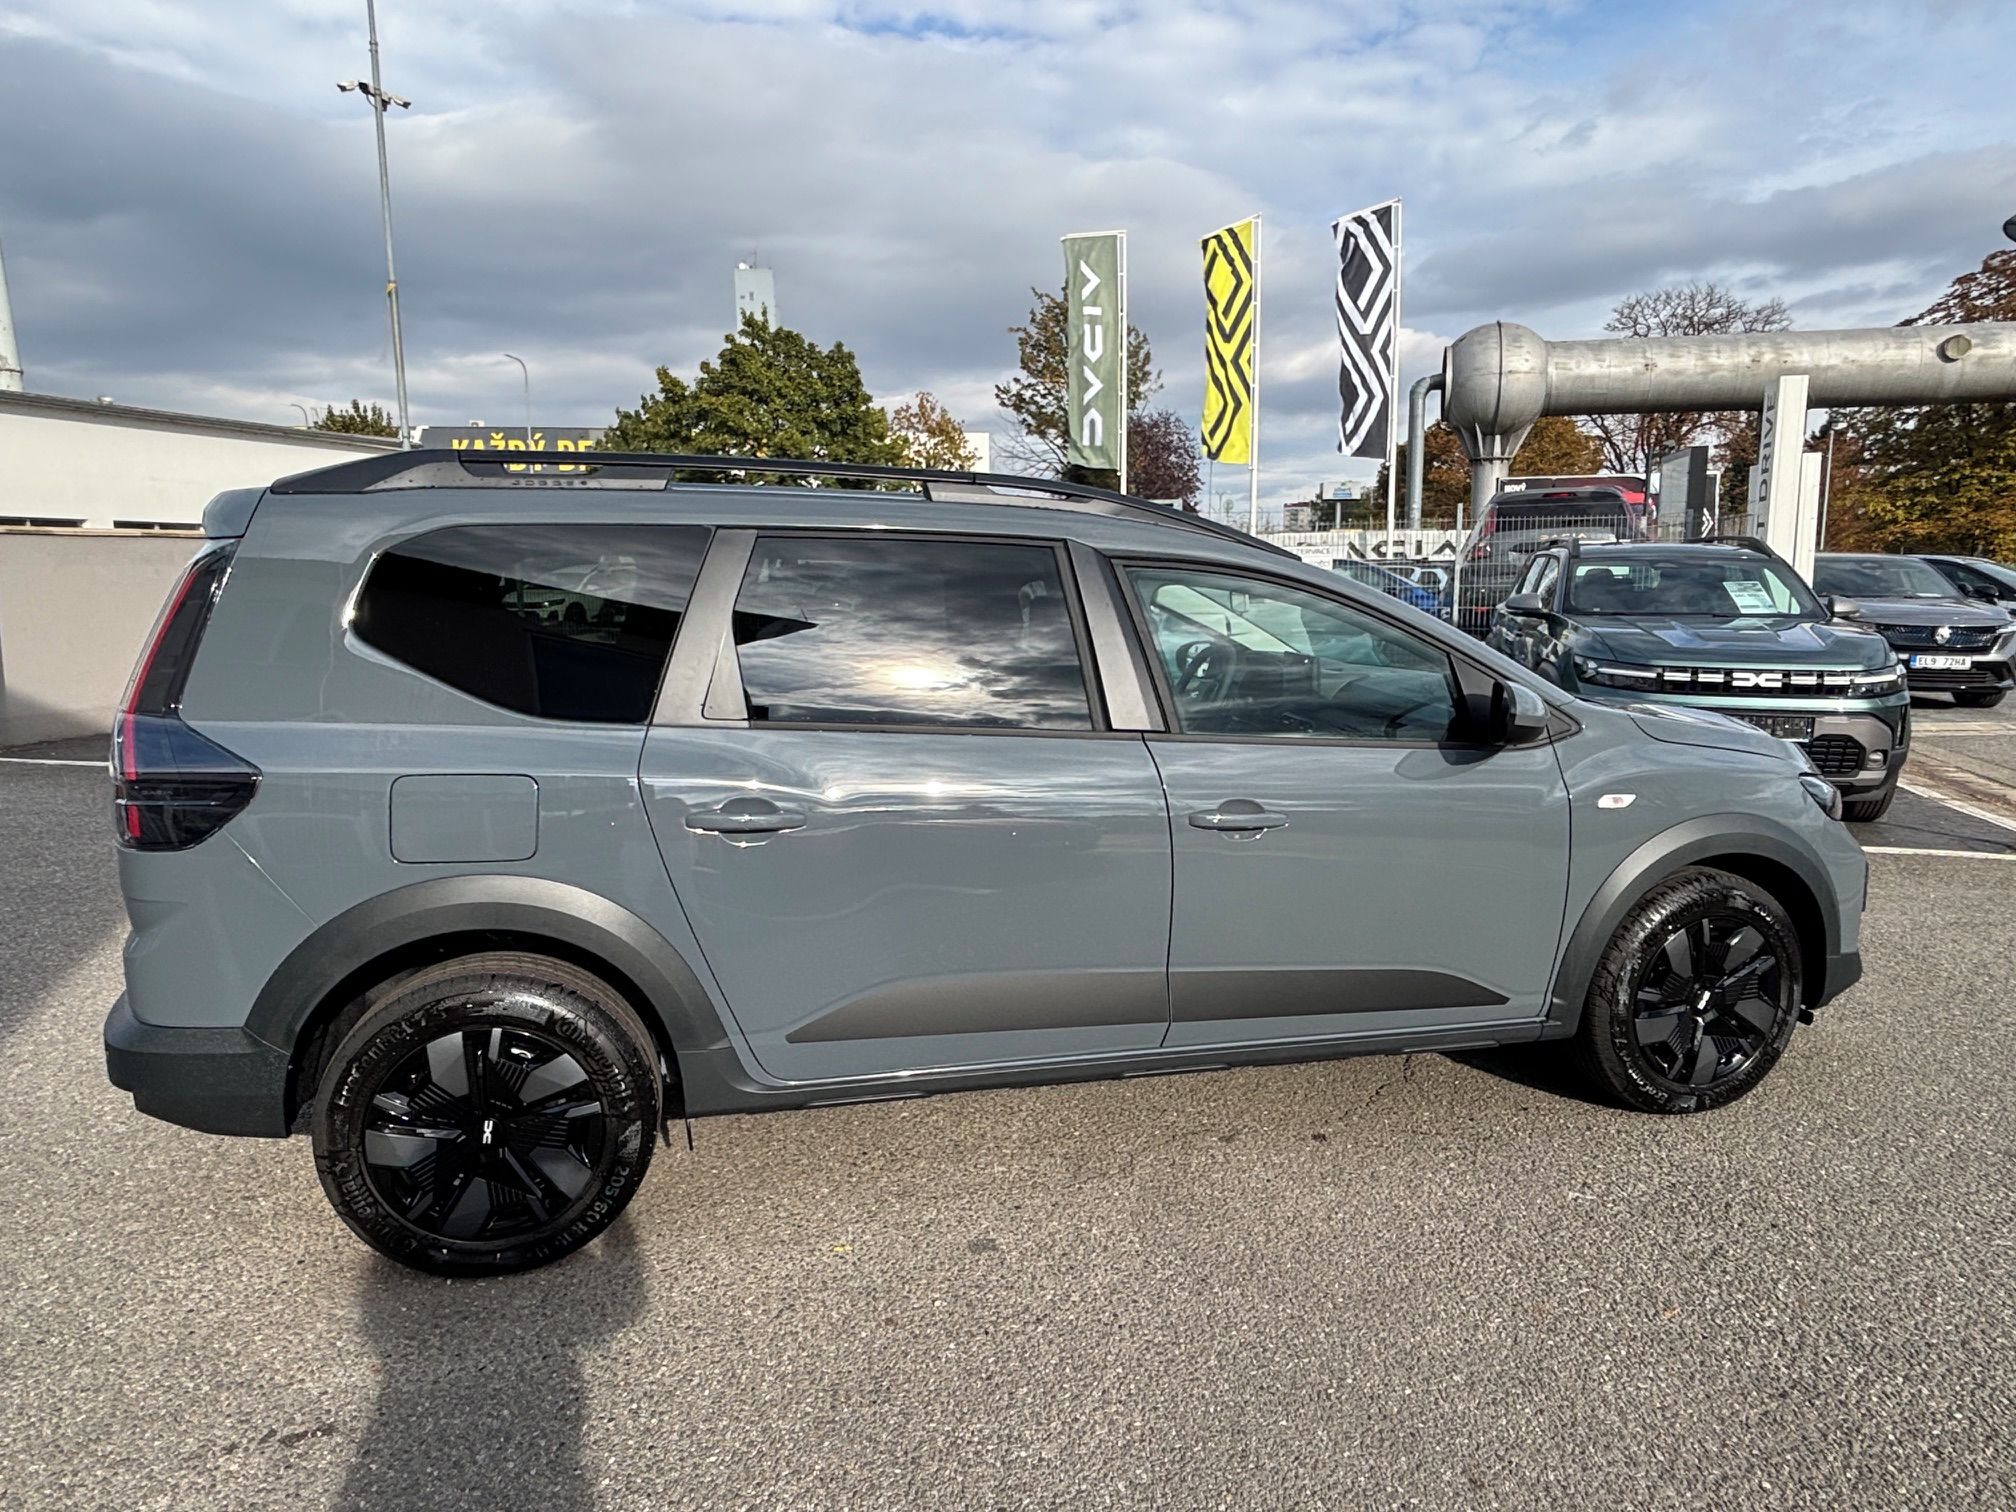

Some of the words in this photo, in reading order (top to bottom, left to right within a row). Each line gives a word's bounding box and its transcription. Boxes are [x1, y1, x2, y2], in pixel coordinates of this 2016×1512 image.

[1080, 259, 1104, 446] DACIA
[1759, 392, 1775, 503] DRIVE
[1919, 657, 1937, 667] EL9
[586, 1166, 630, 1223] 205/60
